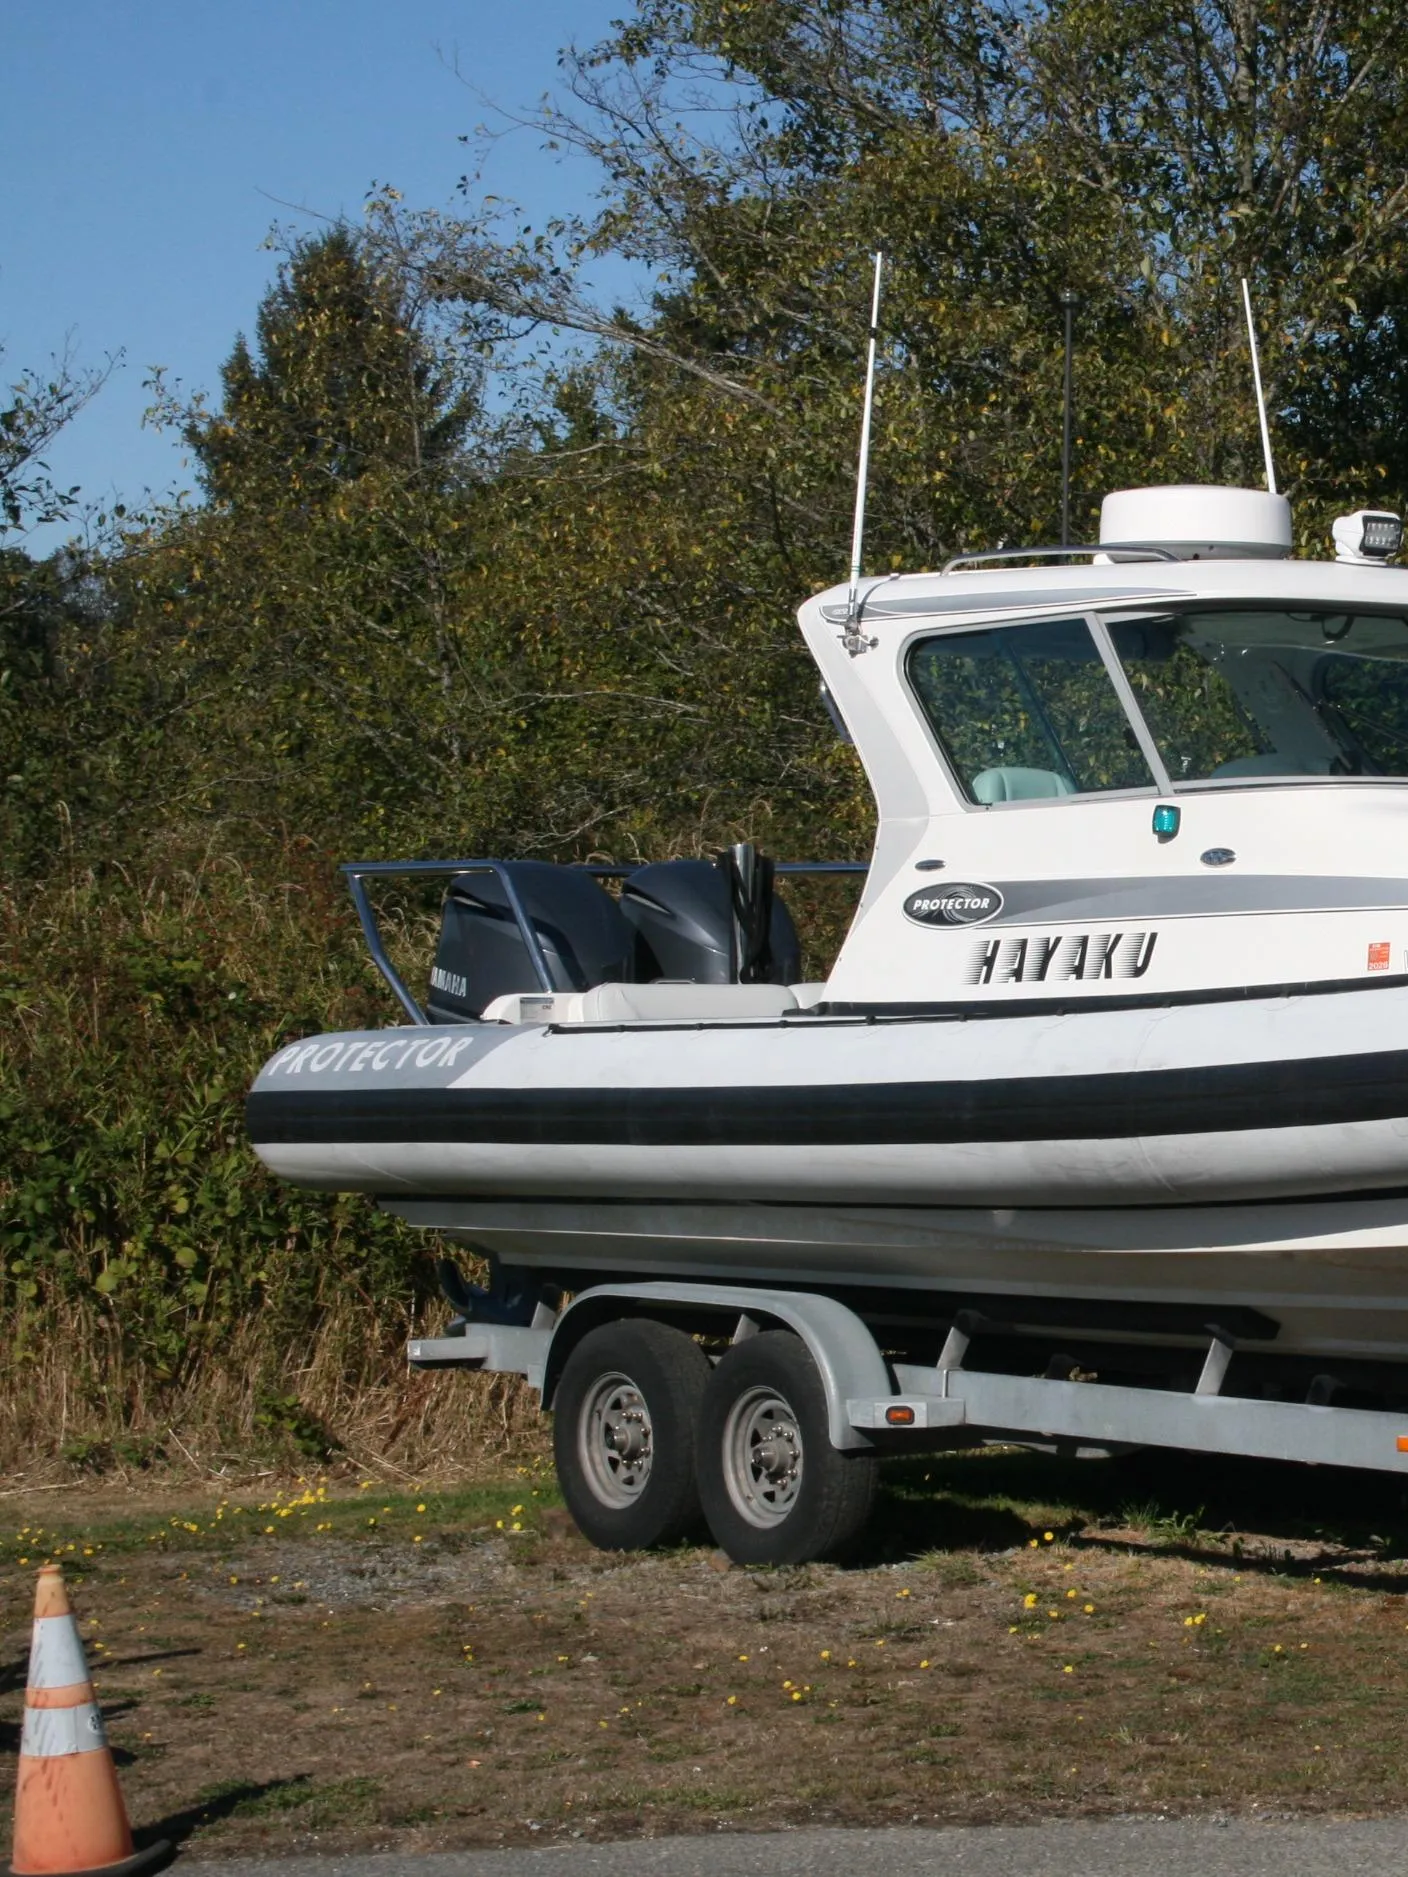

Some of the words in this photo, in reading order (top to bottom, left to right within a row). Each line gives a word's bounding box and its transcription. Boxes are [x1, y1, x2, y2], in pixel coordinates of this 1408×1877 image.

[913, 897, 990, 911] PROTECTOR
[960, 932, 1158, 985] HAYAKU
[430, 966, 467, 997] AMAHA
[268, 1036, 474, 1076] PROTECTOR
